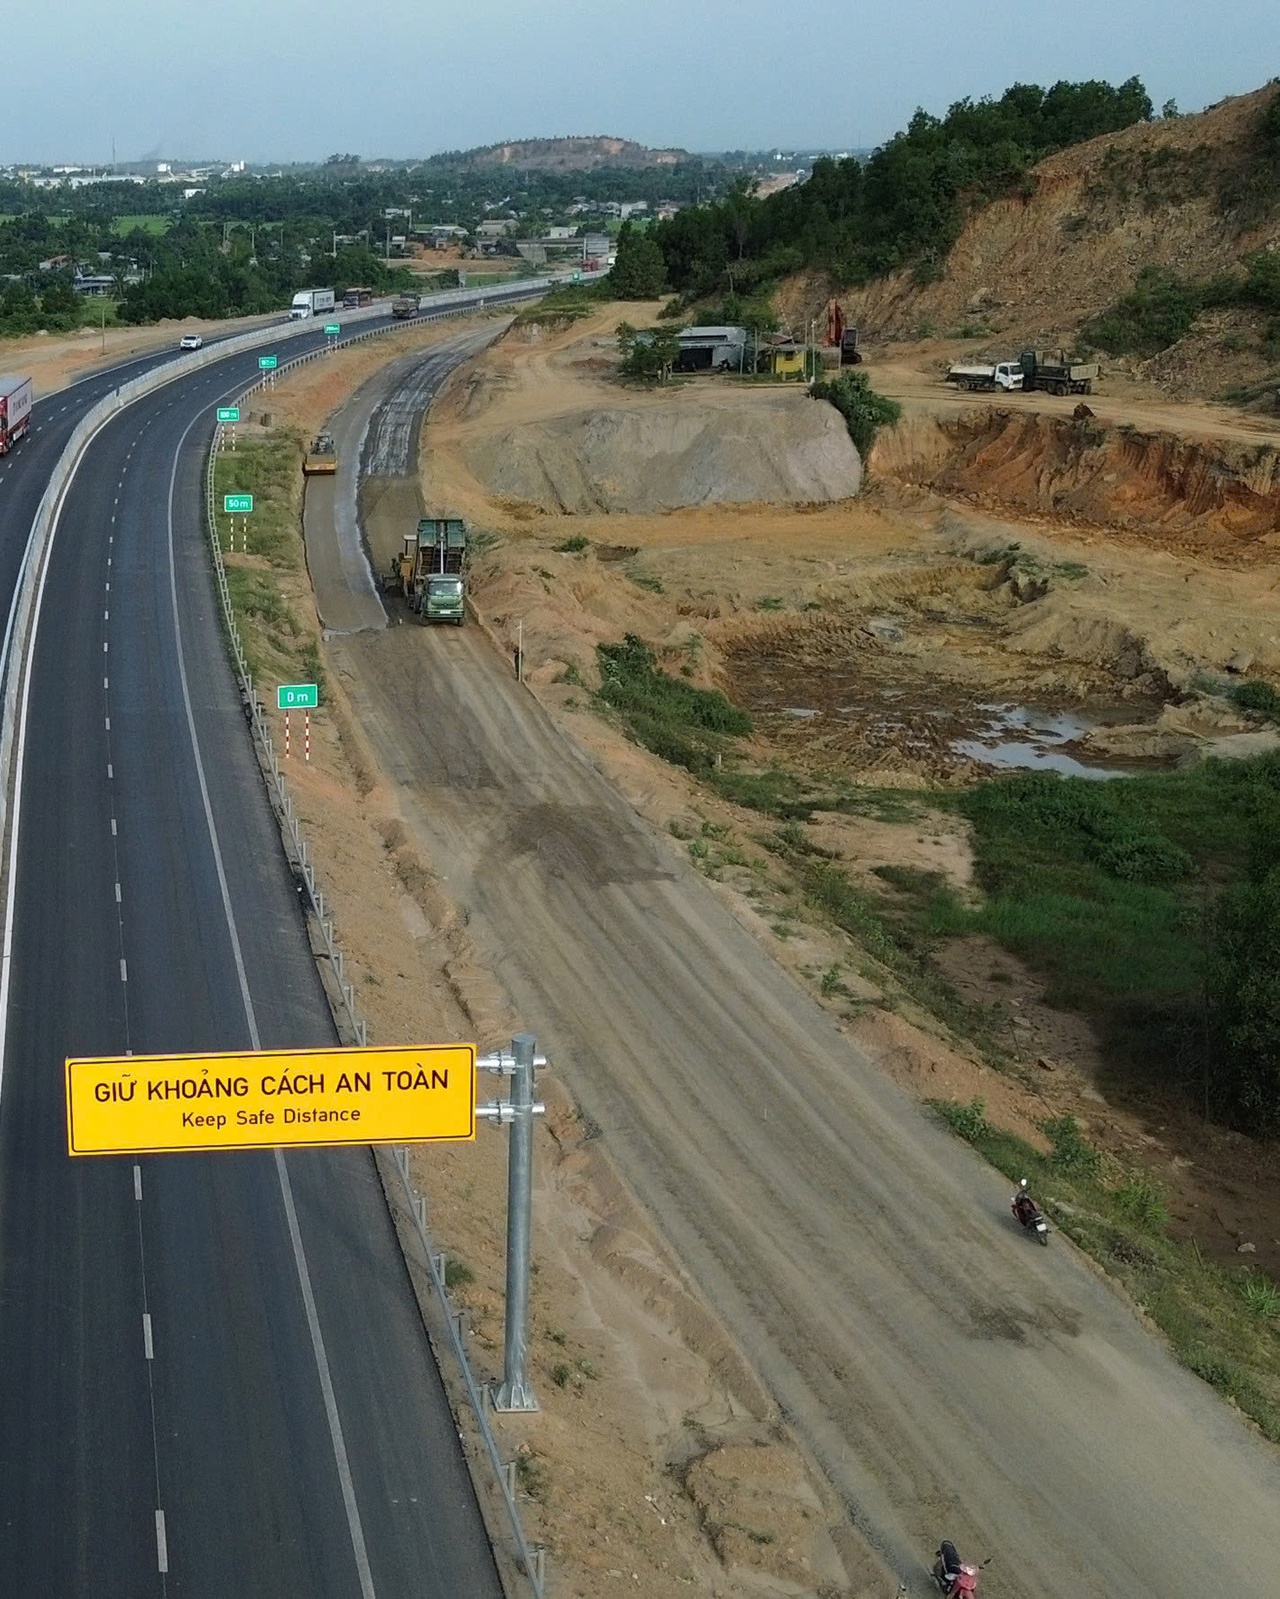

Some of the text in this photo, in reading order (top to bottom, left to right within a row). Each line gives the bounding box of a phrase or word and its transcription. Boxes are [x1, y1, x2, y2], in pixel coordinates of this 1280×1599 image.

[229, 499, 239, 508] 50
[287, 691, 308, 702] 0 m
[95, 1063, 448, 1102] GIỮ KHOẢNG CÁCH AN TOÀN
[182, 1108, 361, 1129] Keep Safe Distance
